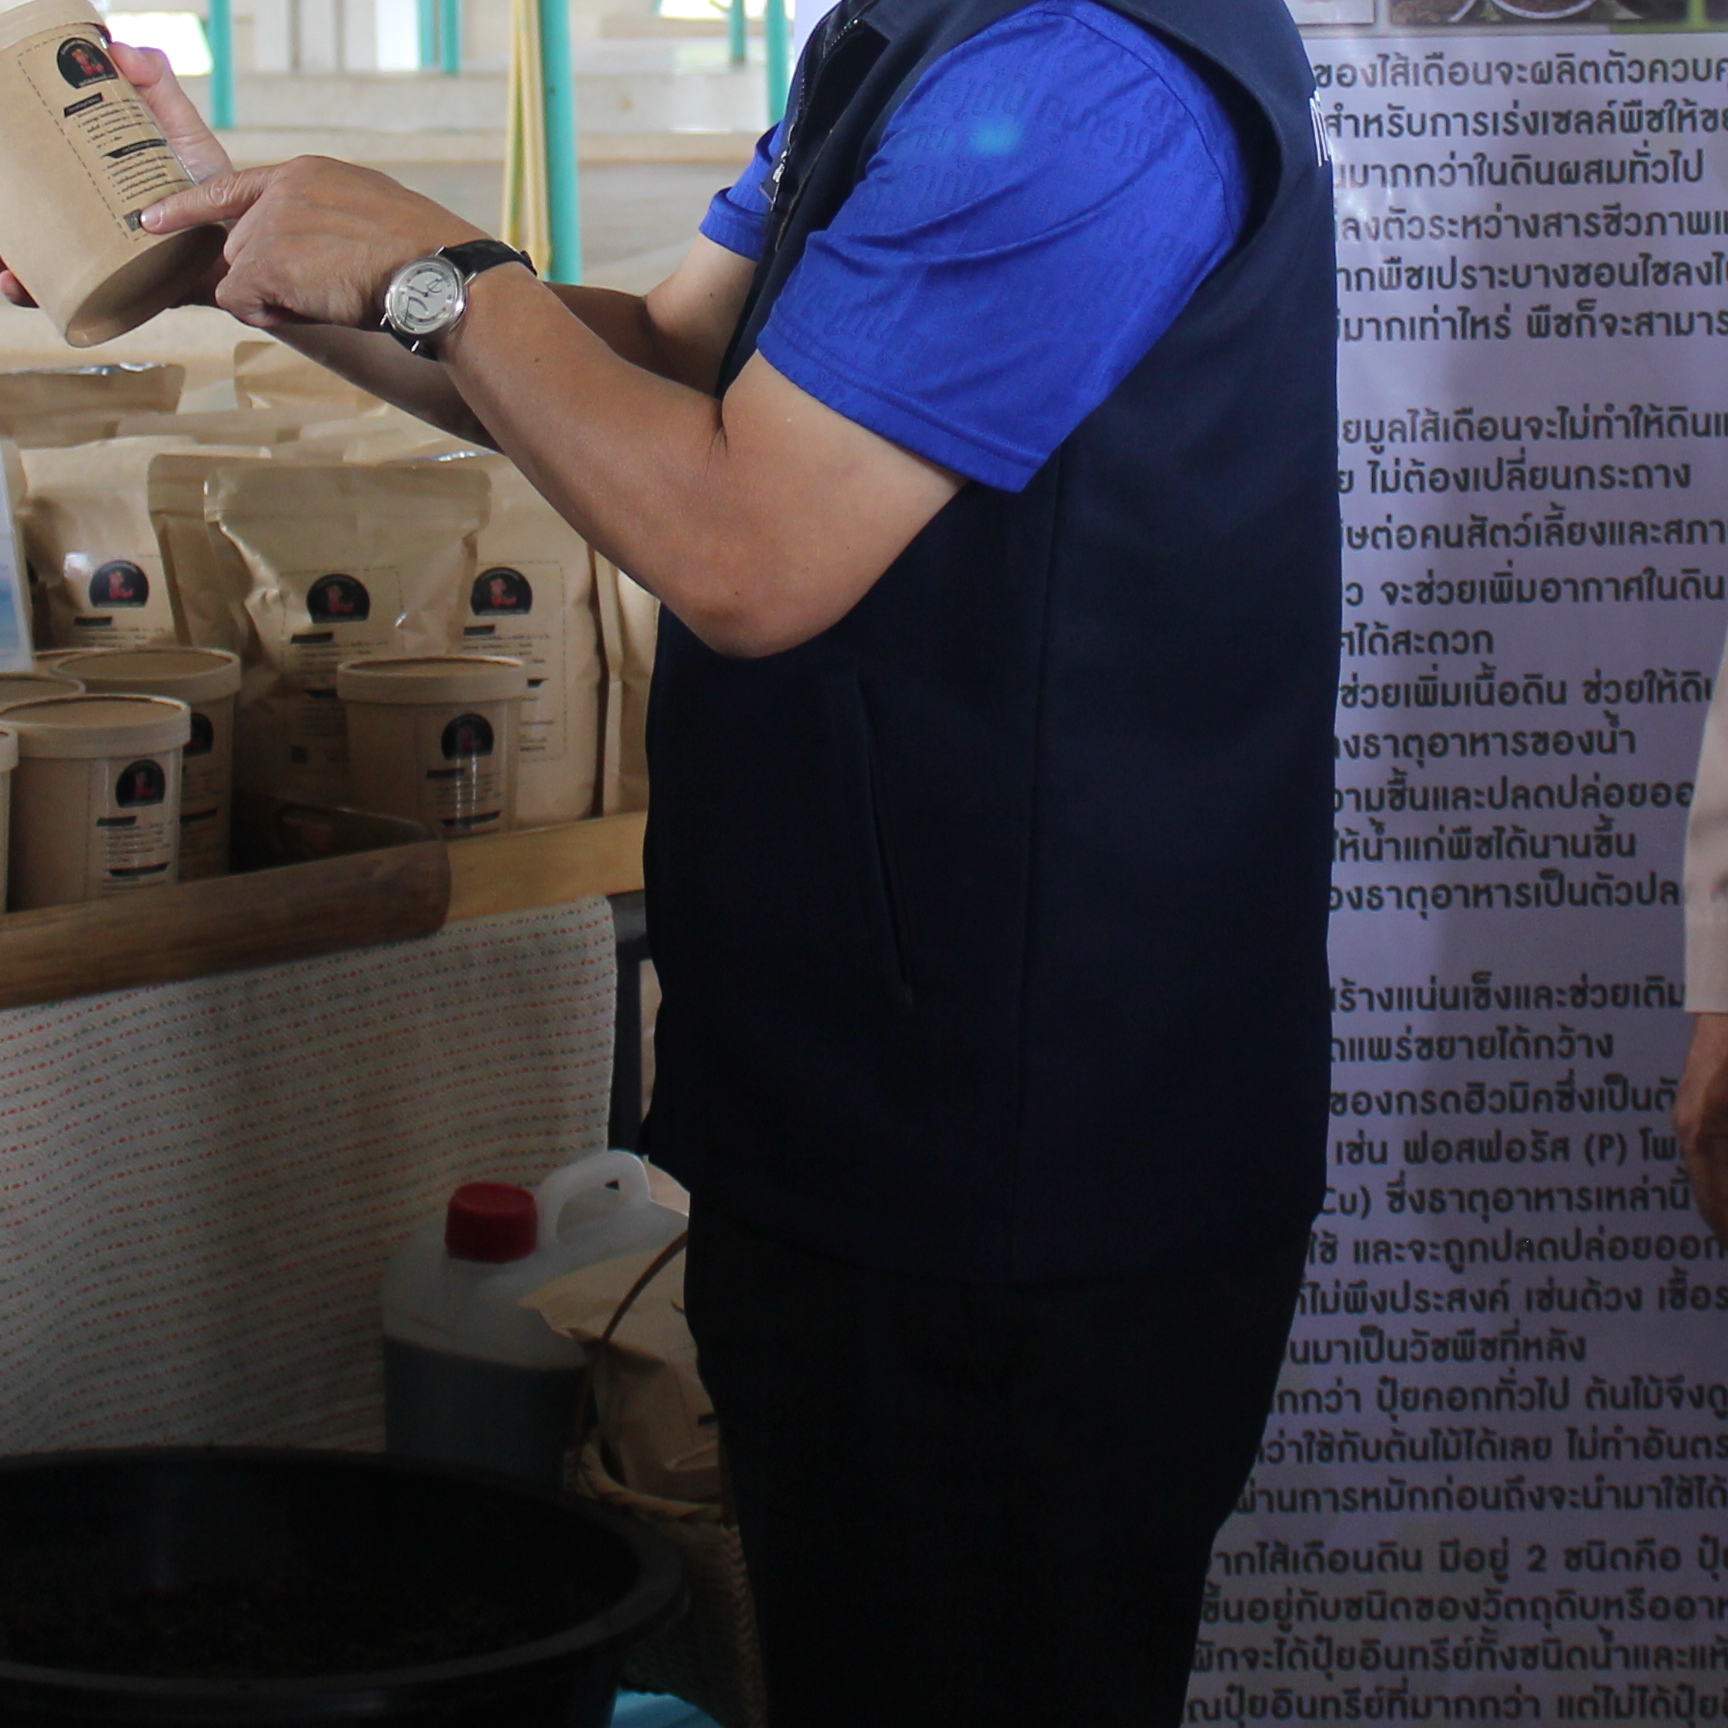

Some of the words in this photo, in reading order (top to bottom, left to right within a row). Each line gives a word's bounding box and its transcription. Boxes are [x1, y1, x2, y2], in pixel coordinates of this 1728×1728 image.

[1367, 447, 1691, 494] ไม่ต้องเปลี่ยนกระถาง
[1380, 559, 1726, 605] จะช่วยเพิ่มอากาศในดิน
[1583, 667, 1713, 705] ช่วยให้ดิ
[1335, 1128, 1388, 1165] เช่น
[1403, 1128, 1570, 1165] ฟอสฟอรัส
[1584, 1132, 1627, 1167] (P)
[1524, 1275, 1643, 1314] เช่นด้วง
[1272, 1376, 1361, 1416] กกว่า
[1376, 1368, 1569, 1424] ปุ๋ยคอกทั่วไป
[1439, 1536, 1509, 1583] มีอยู่
[1527, 1545, 1546, 1572] 2
[1563, 1537, 1681, 1573] ชนิดคือ
